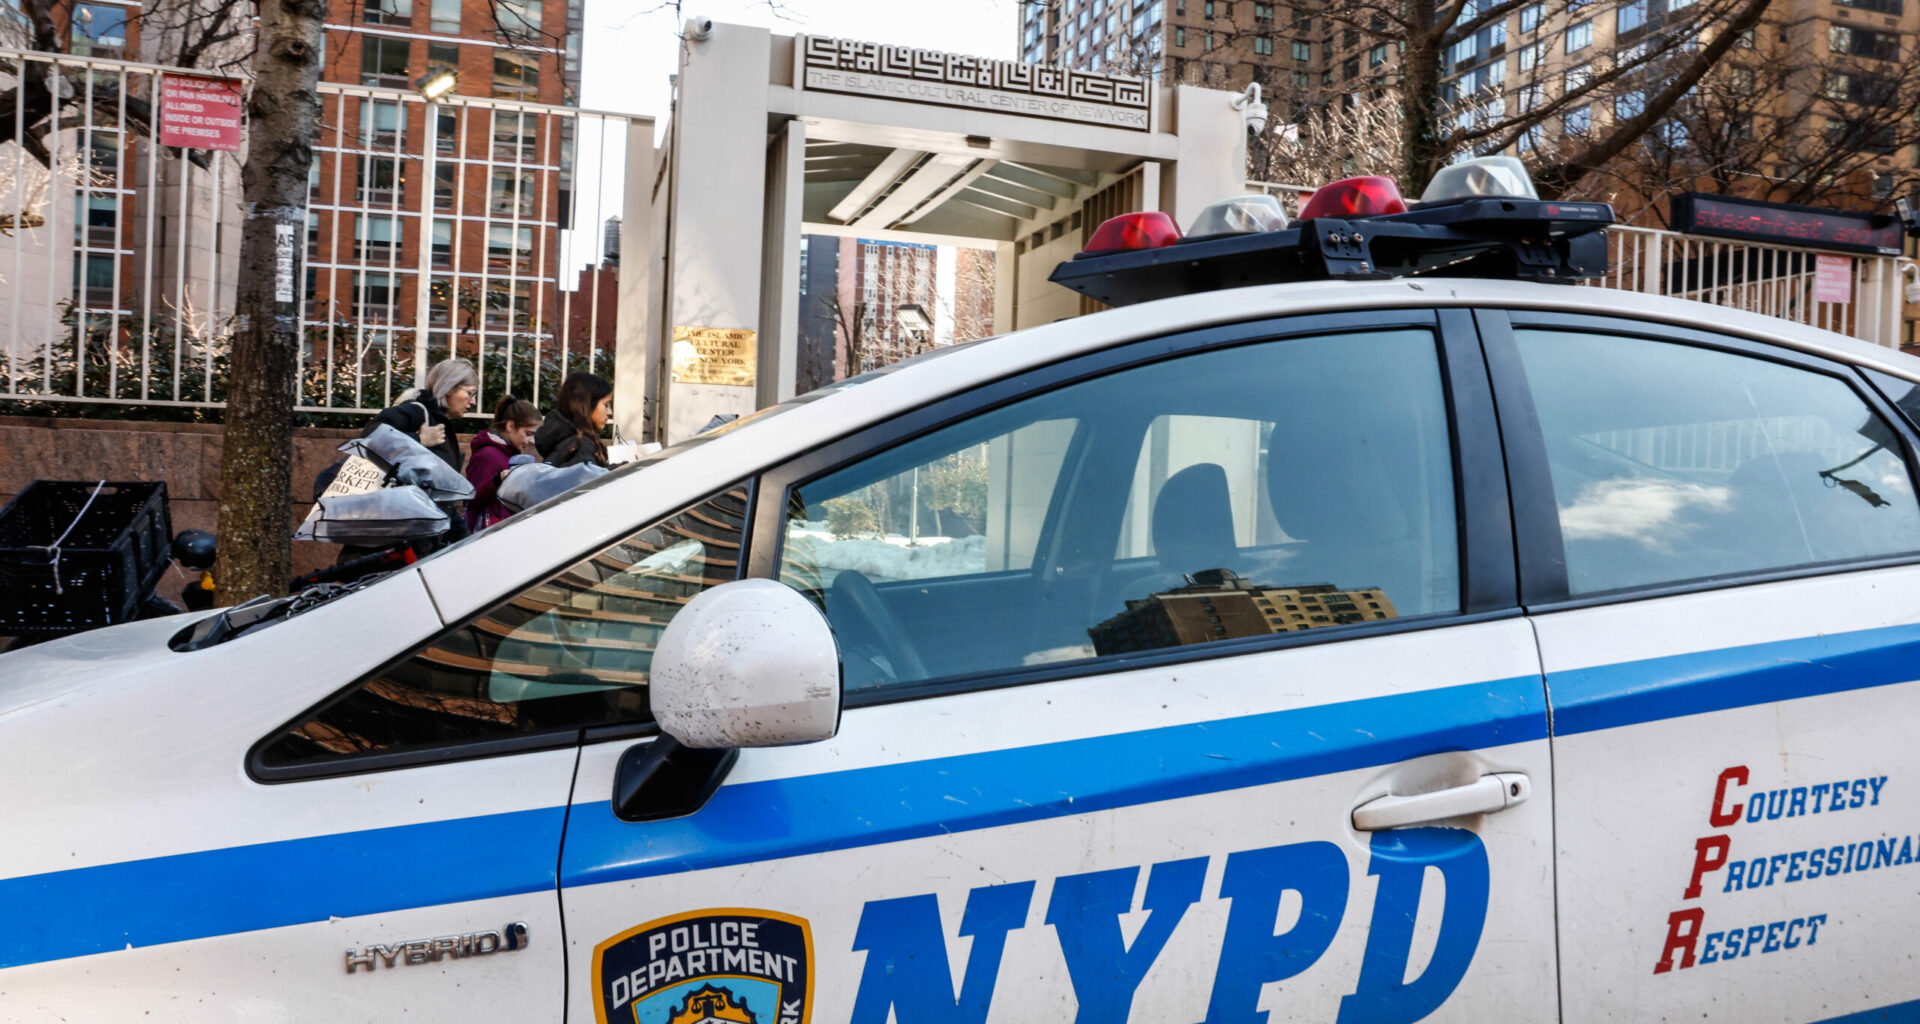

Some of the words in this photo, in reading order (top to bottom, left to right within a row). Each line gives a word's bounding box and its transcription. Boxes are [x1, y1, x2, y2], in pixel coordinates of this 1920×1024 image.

[165, 101, 204, 113] ALLOWED
[809, 71, 841, 86] THE
[844, 75, 905, 94] ISLAMIC
[907, 84, 985, 104] CULTURAL
[988, 94, 1048, 111] CENTER
[1051, 102, 1070, 113] OF
[1072, 105, 1108, 120] NEW
[1107, 109, 1146, 125] YORK
[164, 113, 191, 123] INSIDE
[191, 115, 204, 125] OR
[204, 117, 238, 128] OUTSIDE
[164, 125, 180, 135] THE
[181, 126, 220, 138] PREMISES
[696, 348, 735, 356] CENTER
[720, 358, 746, 366] YORK
[338, 471, 374, 490] RKET
[1709, 765, 1888, 828] COURTESY
[649, 921, 759, 960] POLICE
[850, 827, 1490, 1024] NYPD
[1653, 907, 1828, 975] RESPECT
[345, 930, 500, 974] HYBRID
[611, 948, 797, 1010] DEPARTMENT
